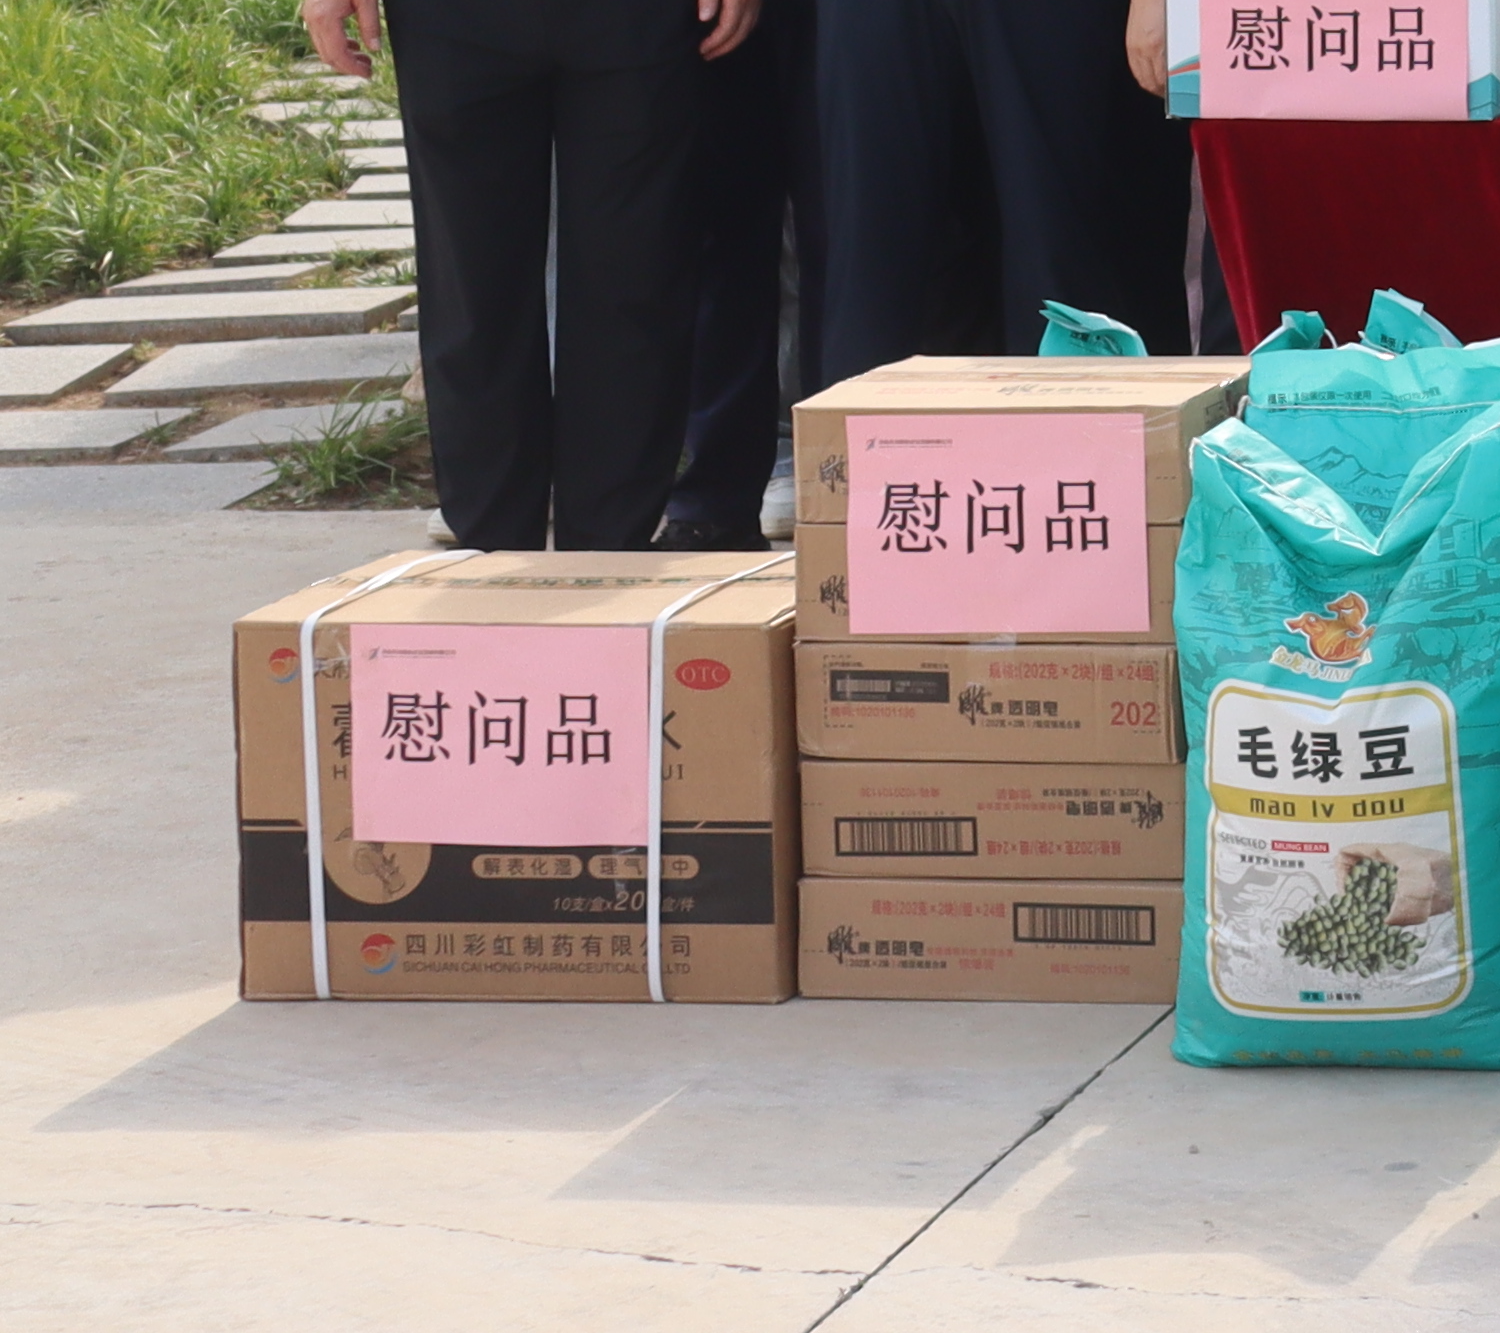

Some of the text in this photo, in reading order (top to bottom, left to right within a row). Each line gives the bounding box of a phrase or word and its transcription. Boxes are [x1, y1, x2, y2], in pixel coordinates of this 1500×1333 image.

[1226, 5, 1435, 72] 慰问品
[876, 479, 1110, 554] 慰问品
[680, 666, 727, 683] OTC
[1110, 701, 1157, 726] 202
[382, 690, 611, 767] 慰问品
[1237, 725, 1414, 783] 毛绿豆
[1250, 795, 1405, 818] mao lv dou
[1219, 836, 1268, 852] SELECTED
[484, 857, 689, 876] 解表化湿 理气中
[553, 891, 695, 912] 10支/盒x20盒/件
[403, 962, 459, 975] SICHUAN
[523, 962, 639, 975] PHARMACEUTICAL
